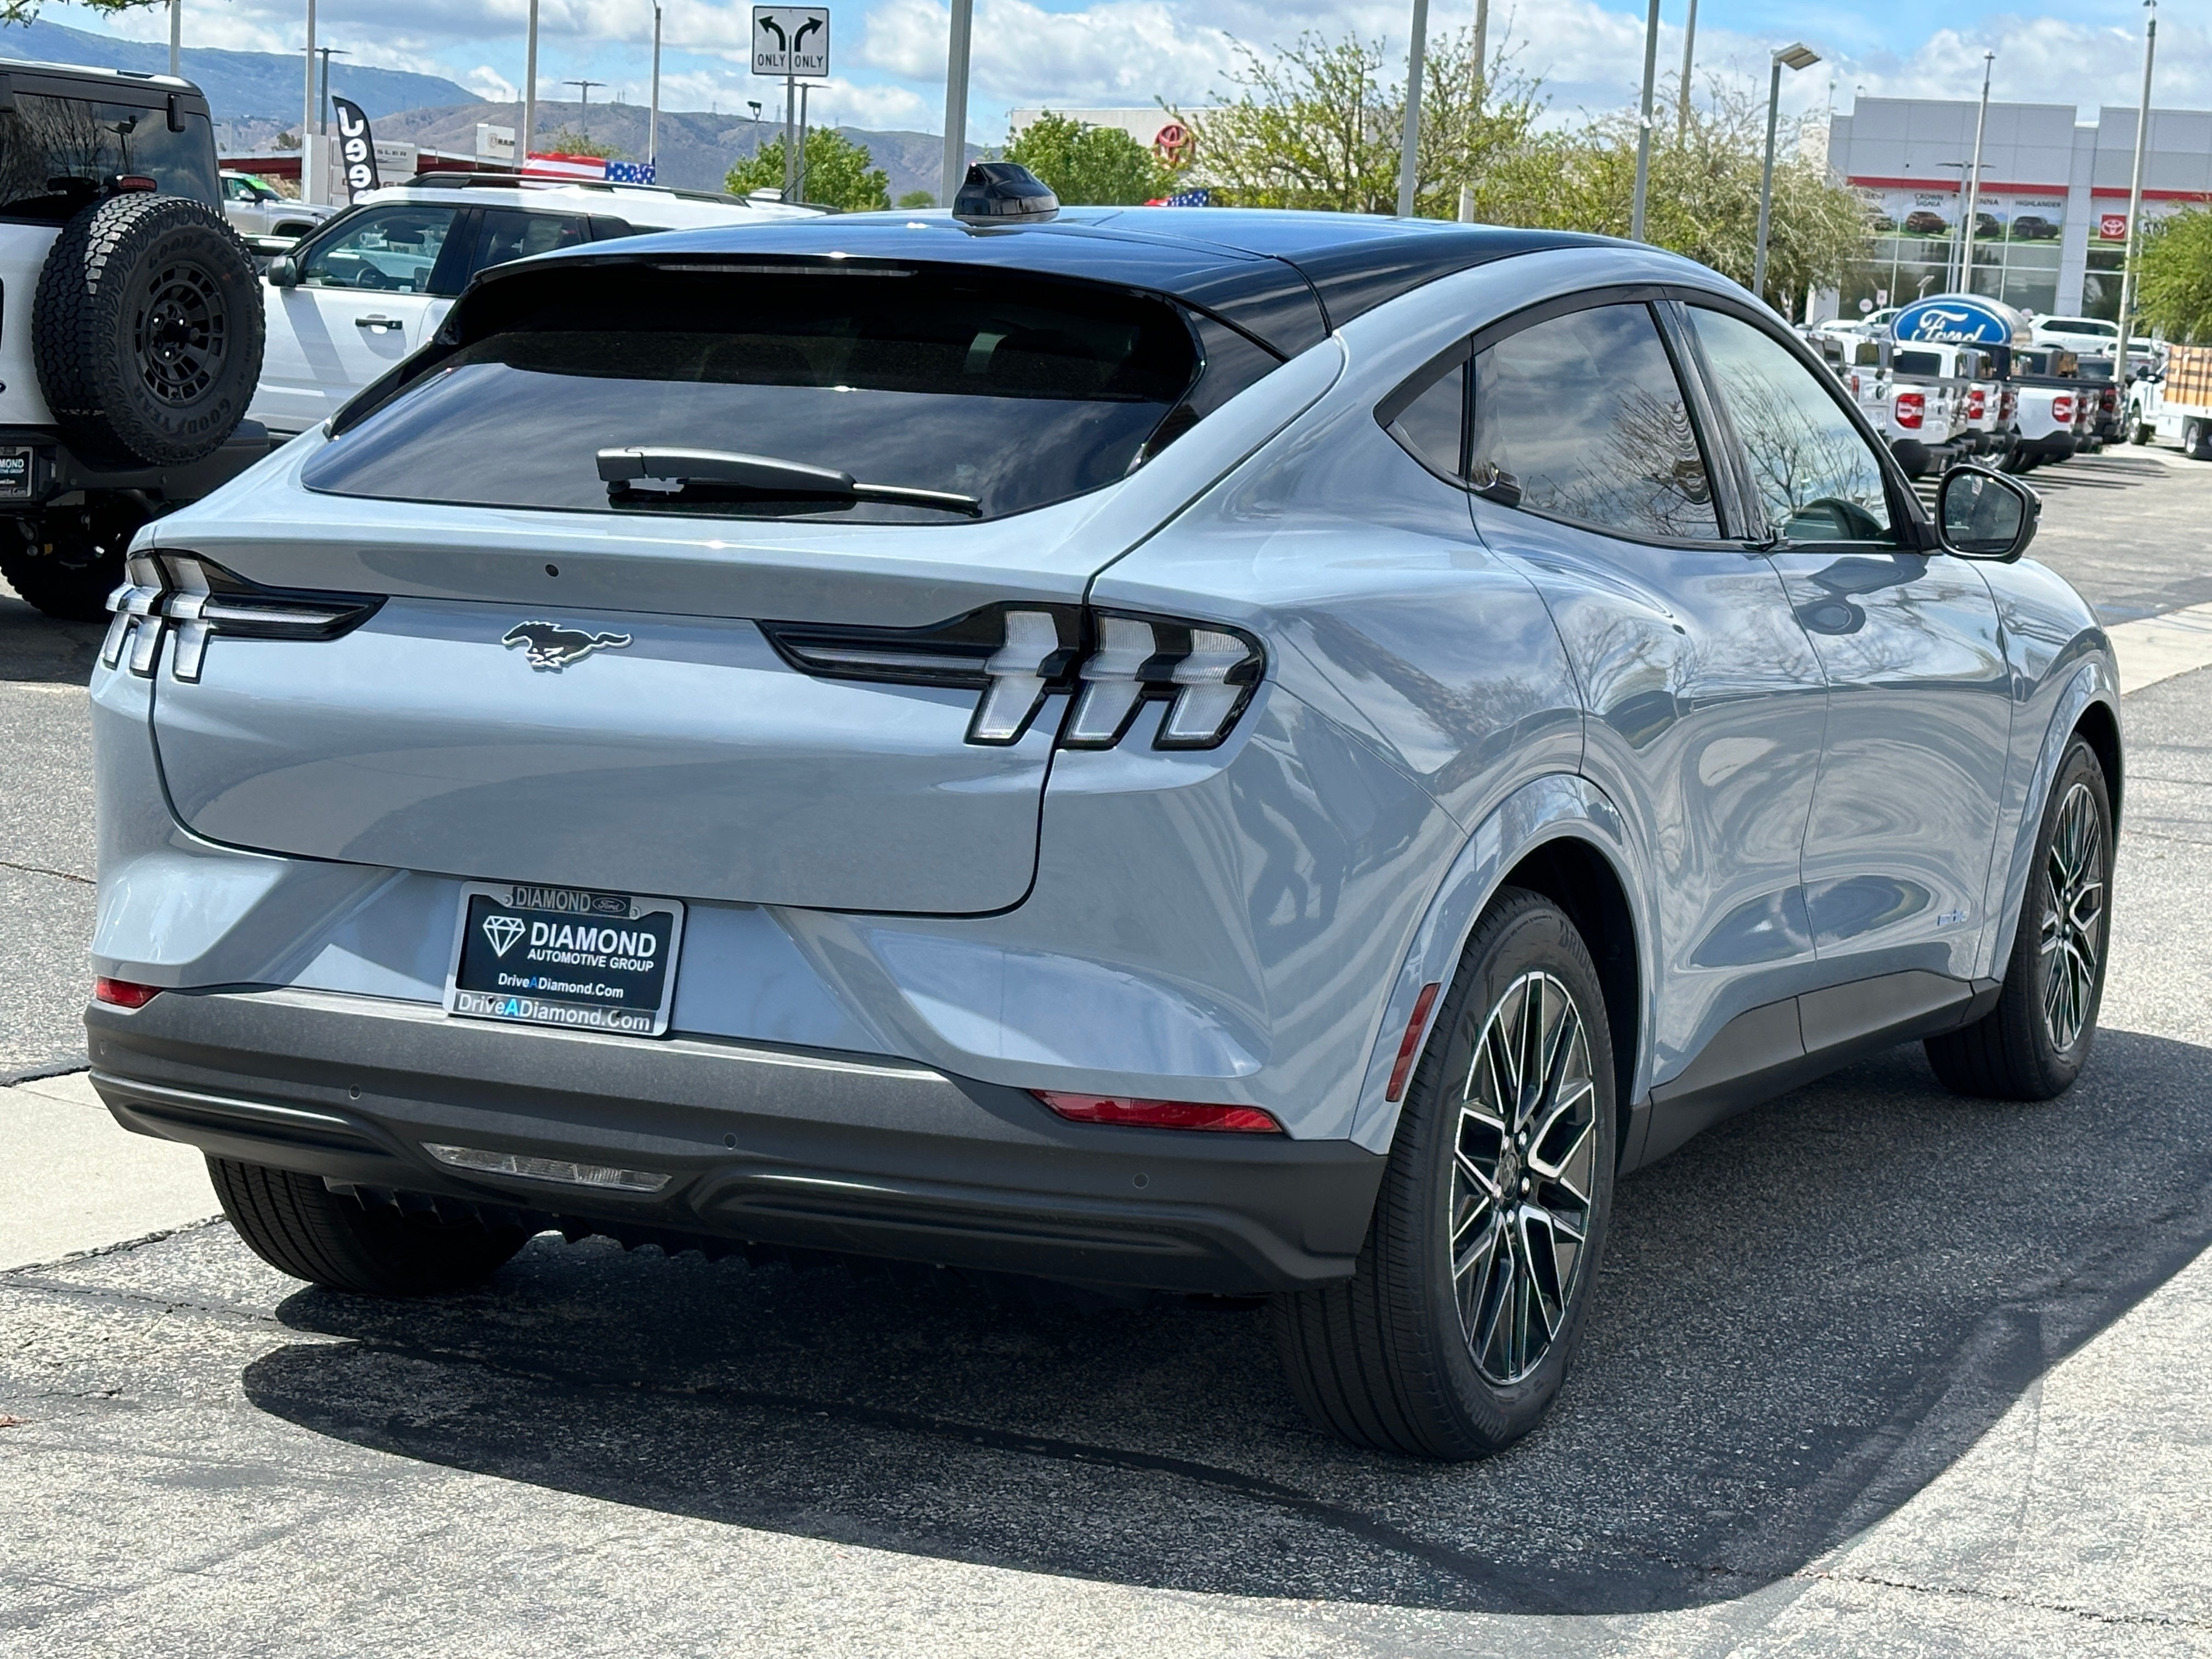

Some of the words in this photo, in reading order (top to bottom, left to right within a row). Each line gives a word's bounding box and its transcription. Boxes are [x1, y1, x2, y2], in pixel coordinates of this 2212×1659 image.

[758, 54, 786, 66] ONLY
[794, 55, 823, 67] ONLY
[0, 458, 24, 468] MOND
[517, 887, 591, 912] DIAMOND
[530, 921, 656, 958] DIAMOND
[527, 949, 606, 967] AUTOMOTIVE
[610, 956, 654, 972] GROUP
[498, 972, 624, 998] DriveADiamond.Com
[458, 992, 650, 1031] DriveADiamond.Com
